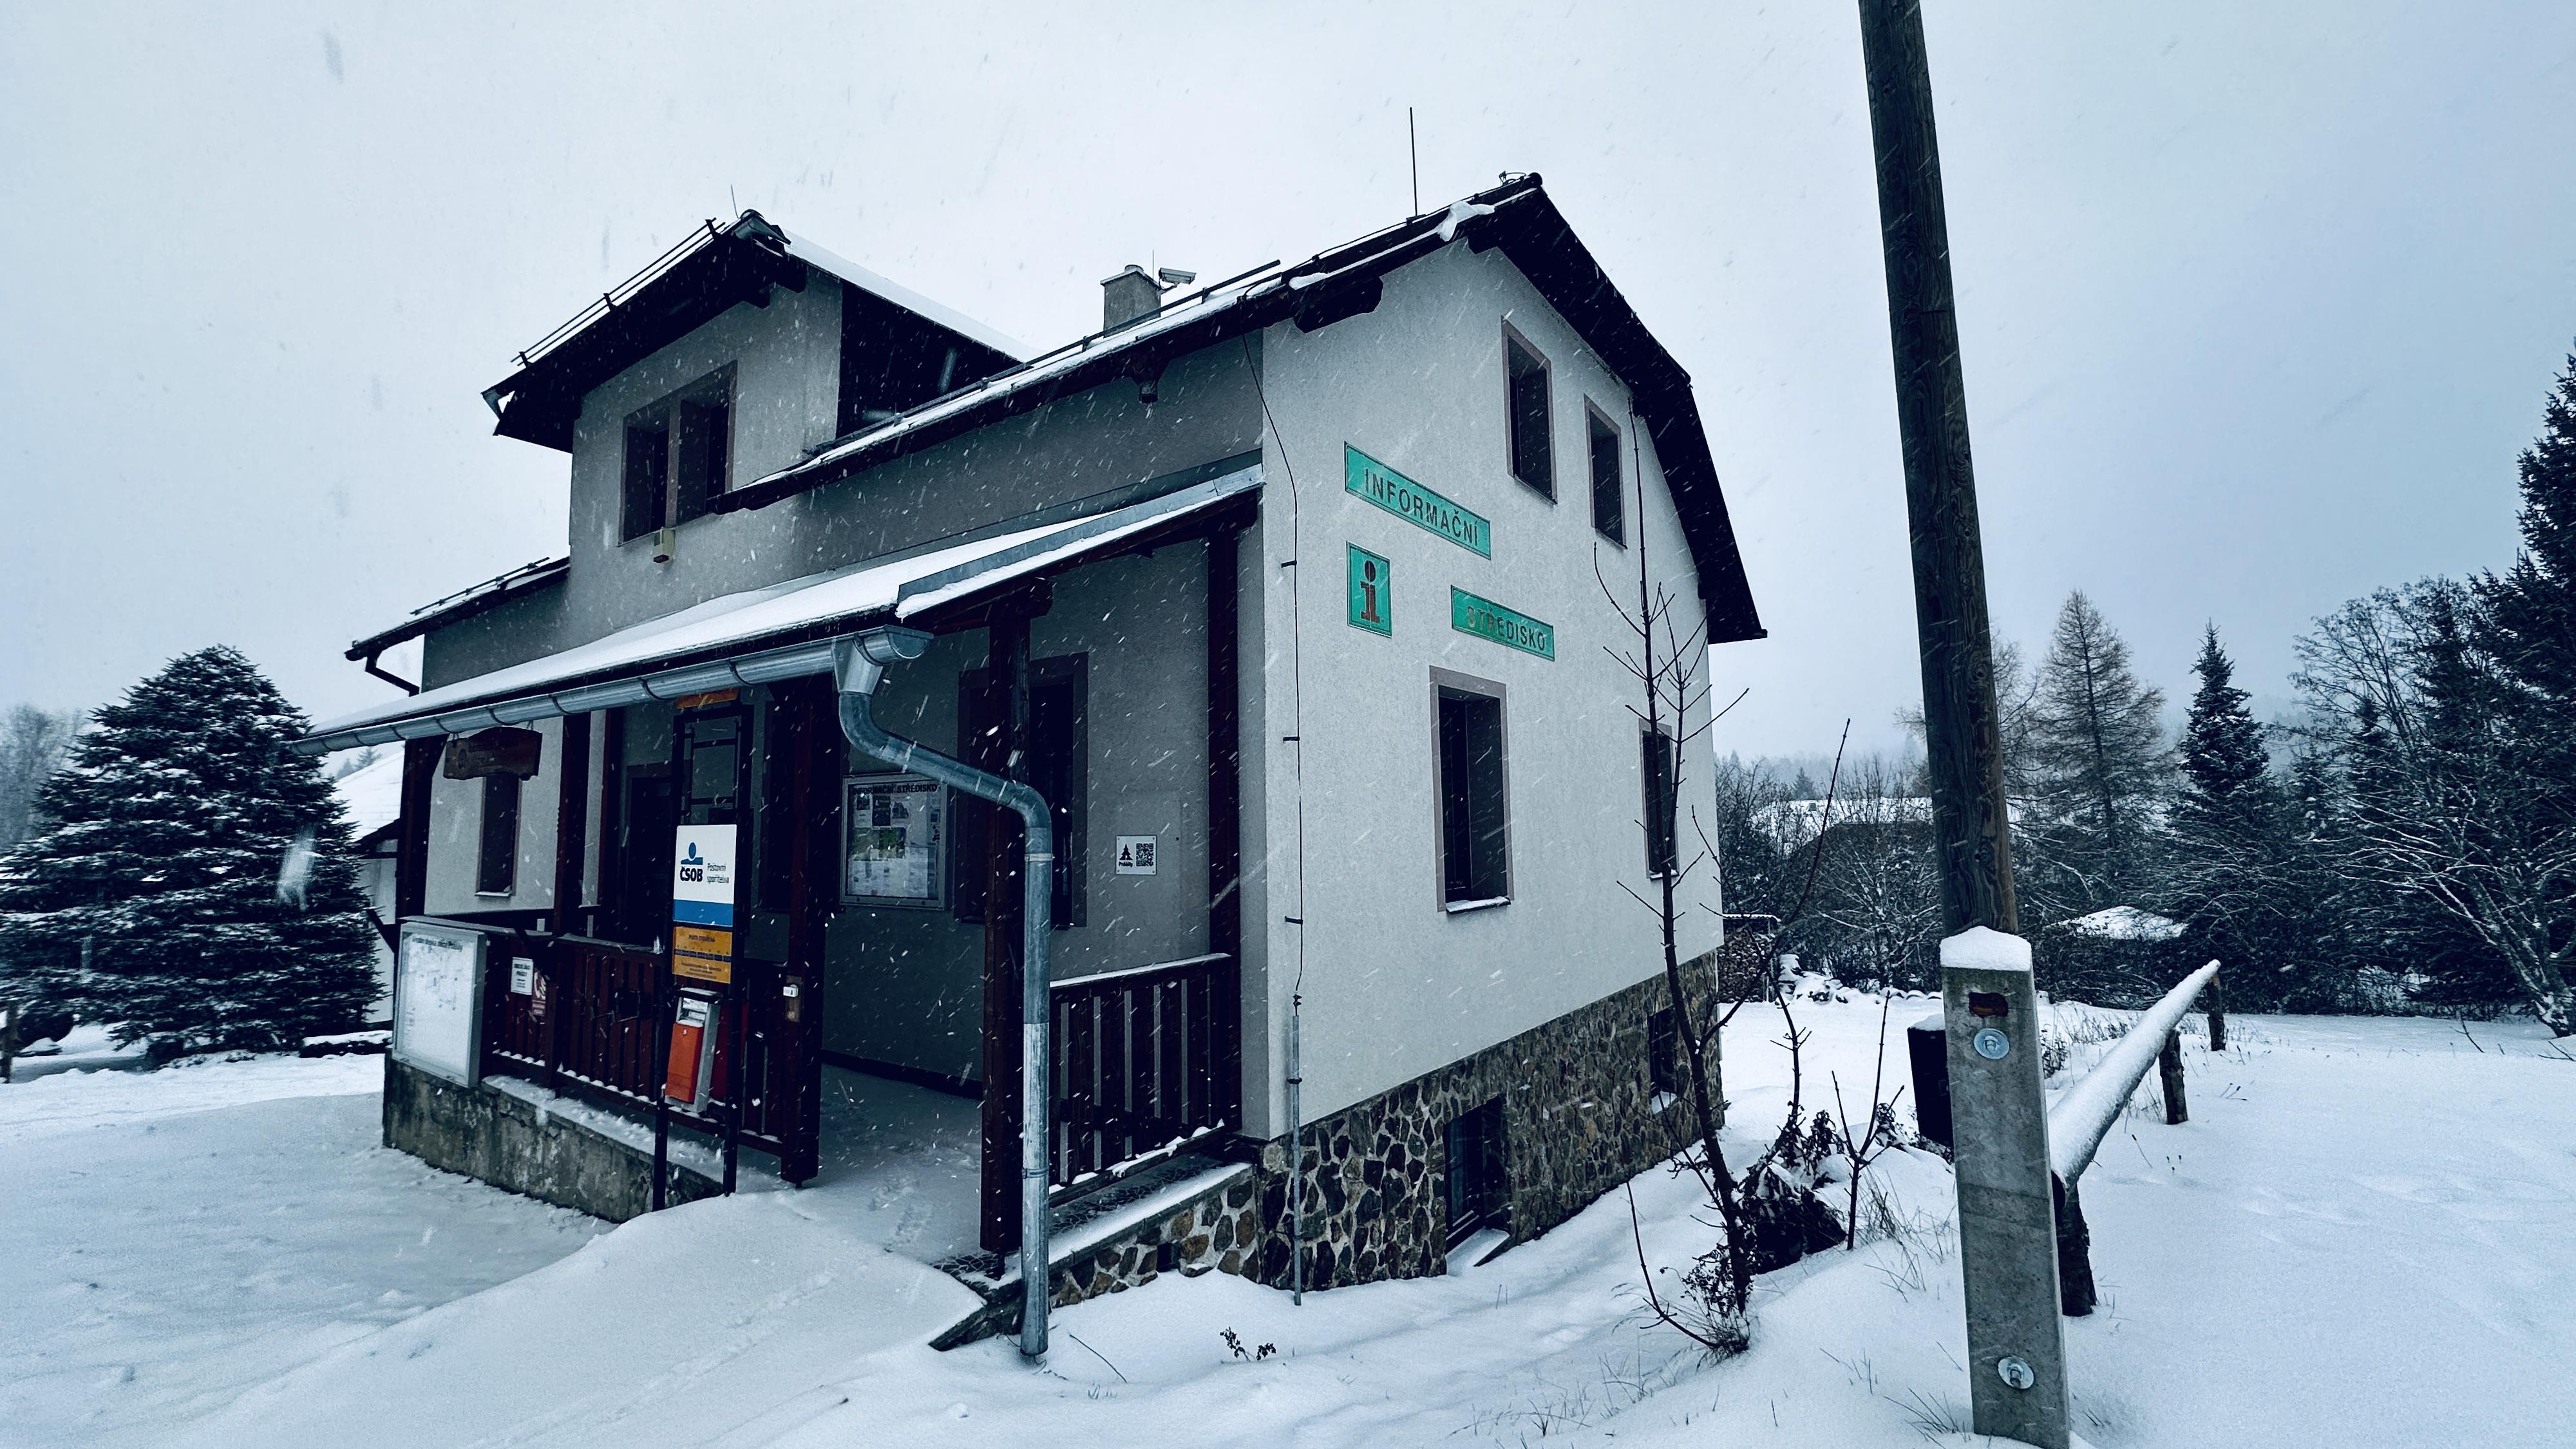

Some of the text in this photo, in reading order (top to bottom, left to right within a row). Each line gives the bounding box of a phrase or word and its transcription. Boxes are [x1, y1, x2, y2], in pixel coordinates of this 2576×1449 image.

[1364, 468, 1479, 546] INFORMAČNÍ
[1359, 560, 1381, 624] i
[1466, 605, 1546, 651] STŘEDISKO
[898, 783, 938, 793] STŘEDISKO
[679, 866, 703, 882] ČSOB
